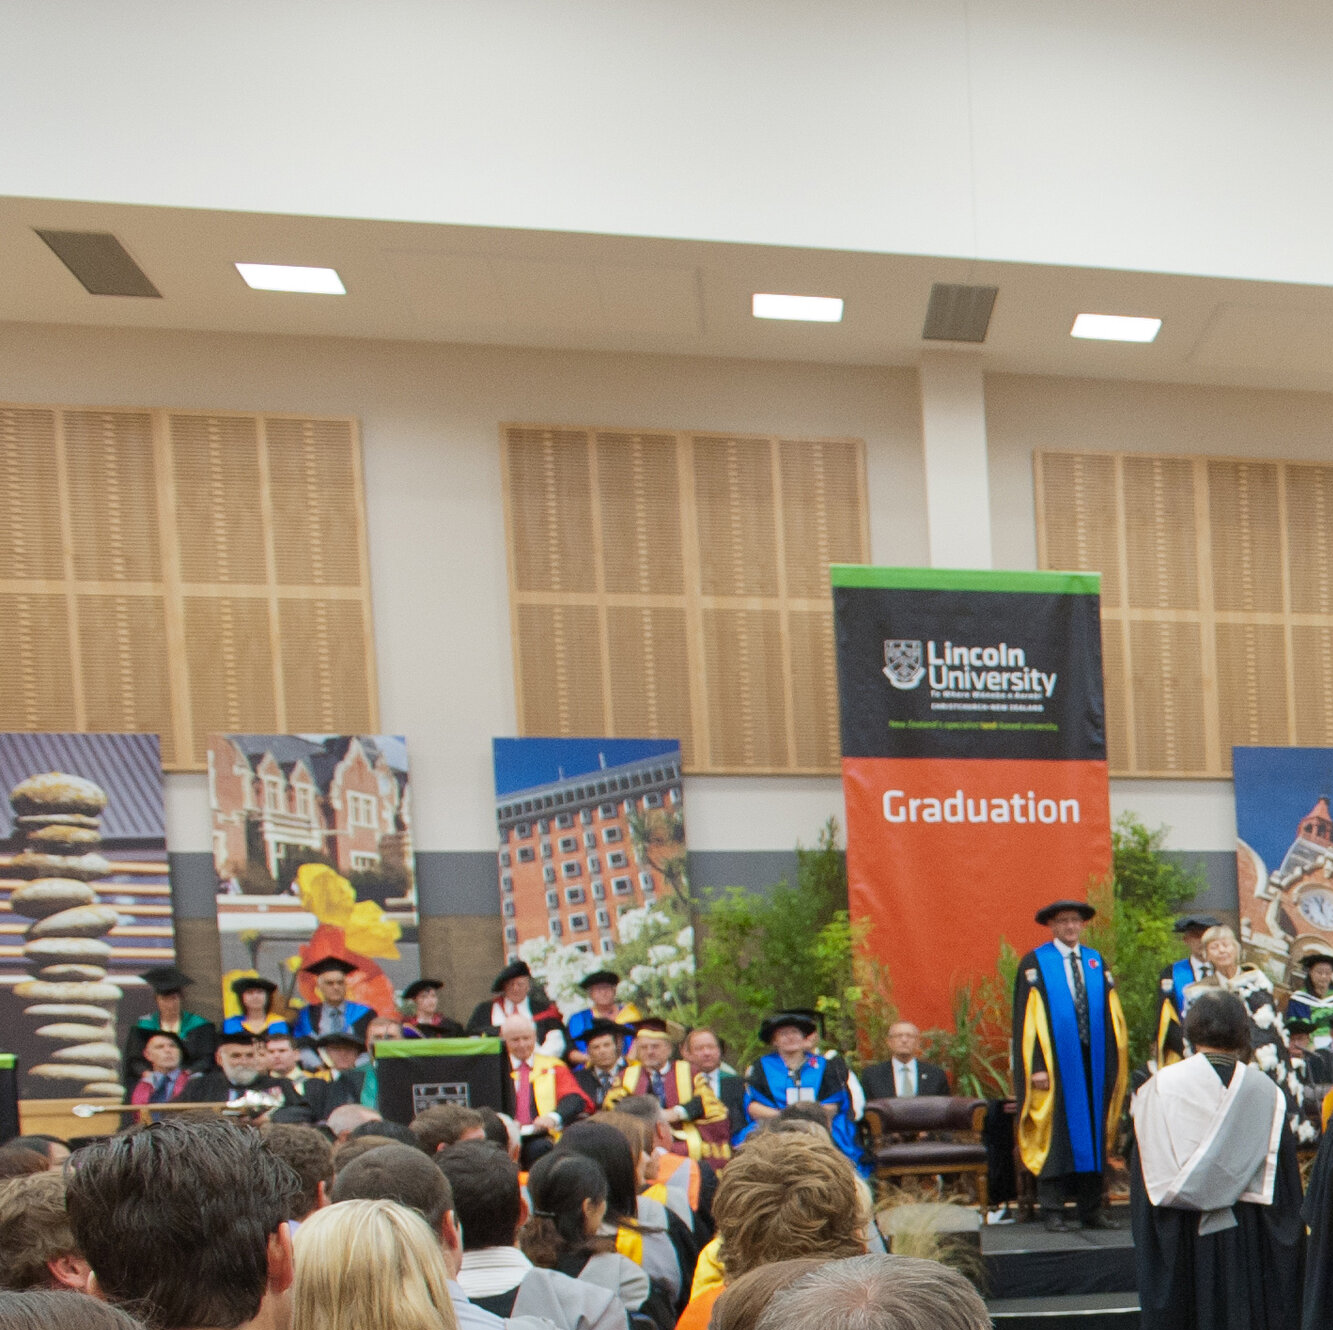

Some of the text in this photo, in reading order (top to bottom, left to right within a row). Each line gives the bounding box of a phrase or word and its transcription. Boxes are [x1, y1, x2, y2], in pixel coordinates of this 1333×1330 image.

[927, 640, 1026, 667] Lincoln
[928, 664, 1057, 698] University
[882, 789, 1080, 824] Graduation
